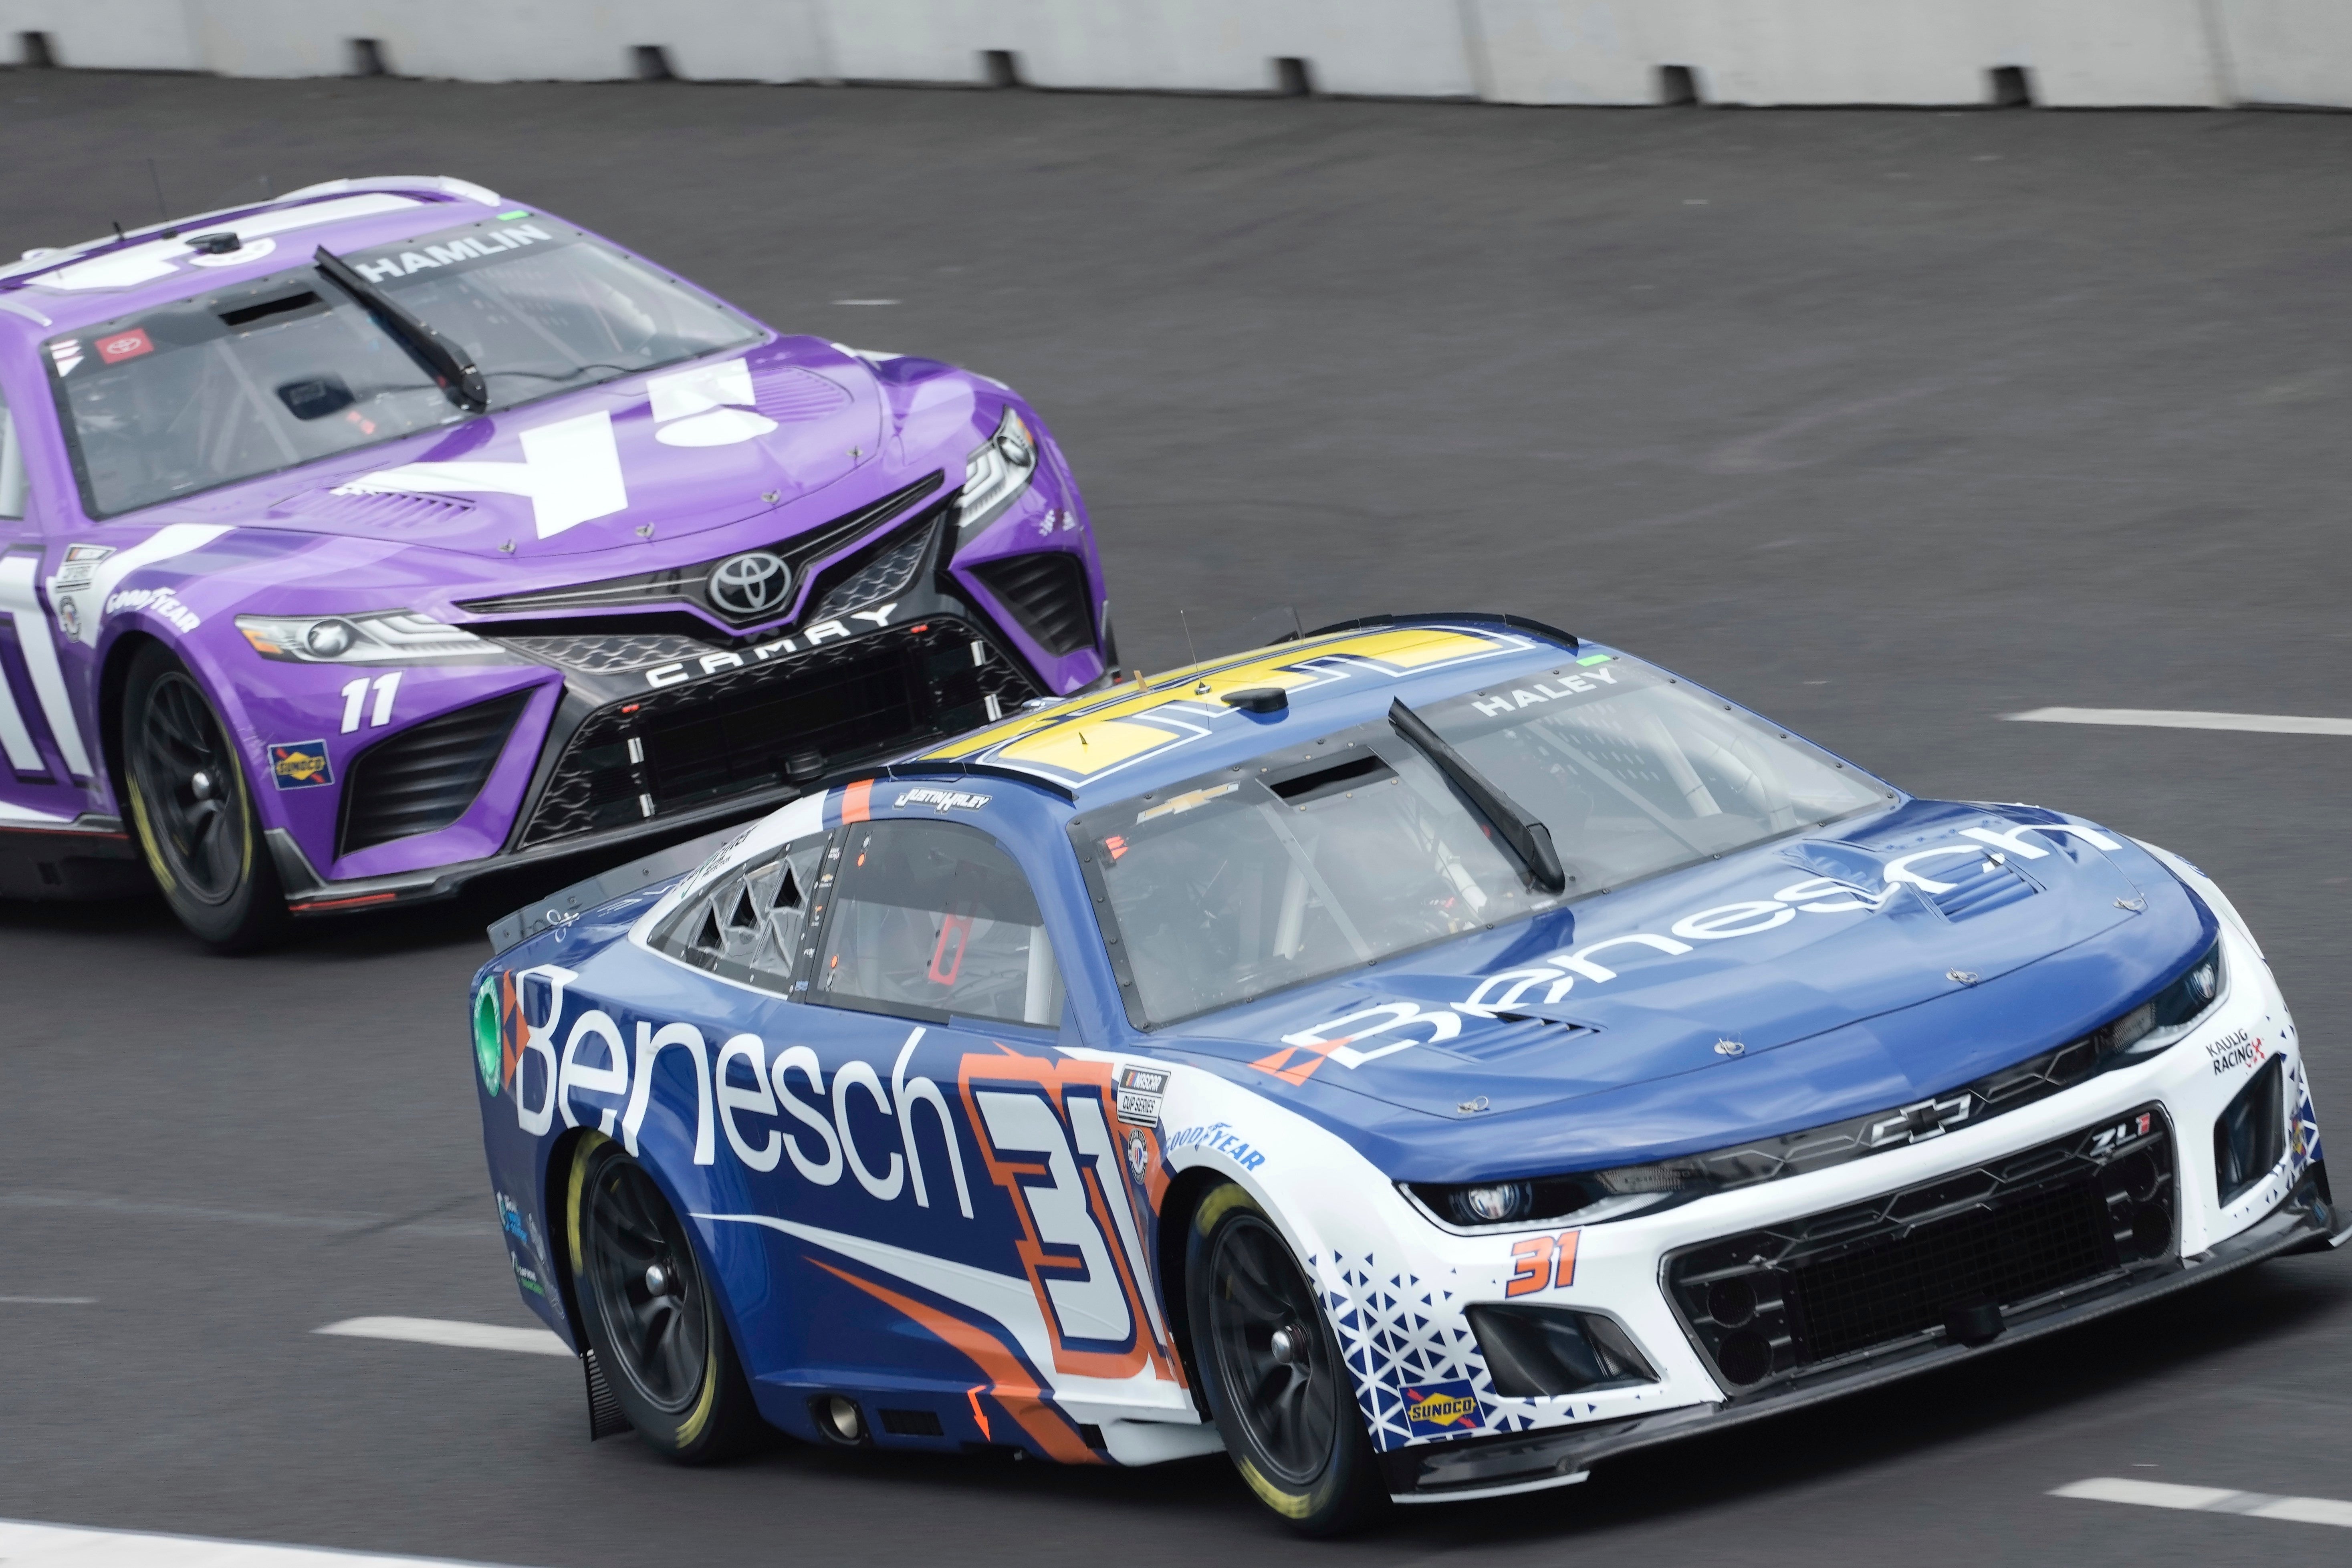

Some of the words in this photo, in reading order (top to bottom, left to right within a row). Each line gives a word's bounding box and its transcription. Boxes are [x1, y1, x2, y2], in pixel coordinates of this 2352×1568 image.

[355, 224, 553, 283] HAMLIN
[106, 586, 201, 633] GOODYEAR
[645, 602, 898, 688] CAMRY
[341, 670, 403, 735] 11
[1471, 667, 1619, 717] HALEY
[1281, 818, 2124, 1071] Benesch
[2205, 1028, 2249, 1058] KAULIG
[2213, 1043, 2254, 1076] RACING
[515, 963, 974, 1219] Benesch
[1123, 1095, 1135, 1112] CUP
[1134, 1097, 1155, 1114] SERIES
[1133, 1071, 1162, 1092] NASCAR
[2089, 1113, 2151, 1158] ZL1
[974, 1089, 1169, 1348] 31
[1505, 1230, 1581, 1299] 31
[1411, 1397, 1472, 1420] SUNOCO
